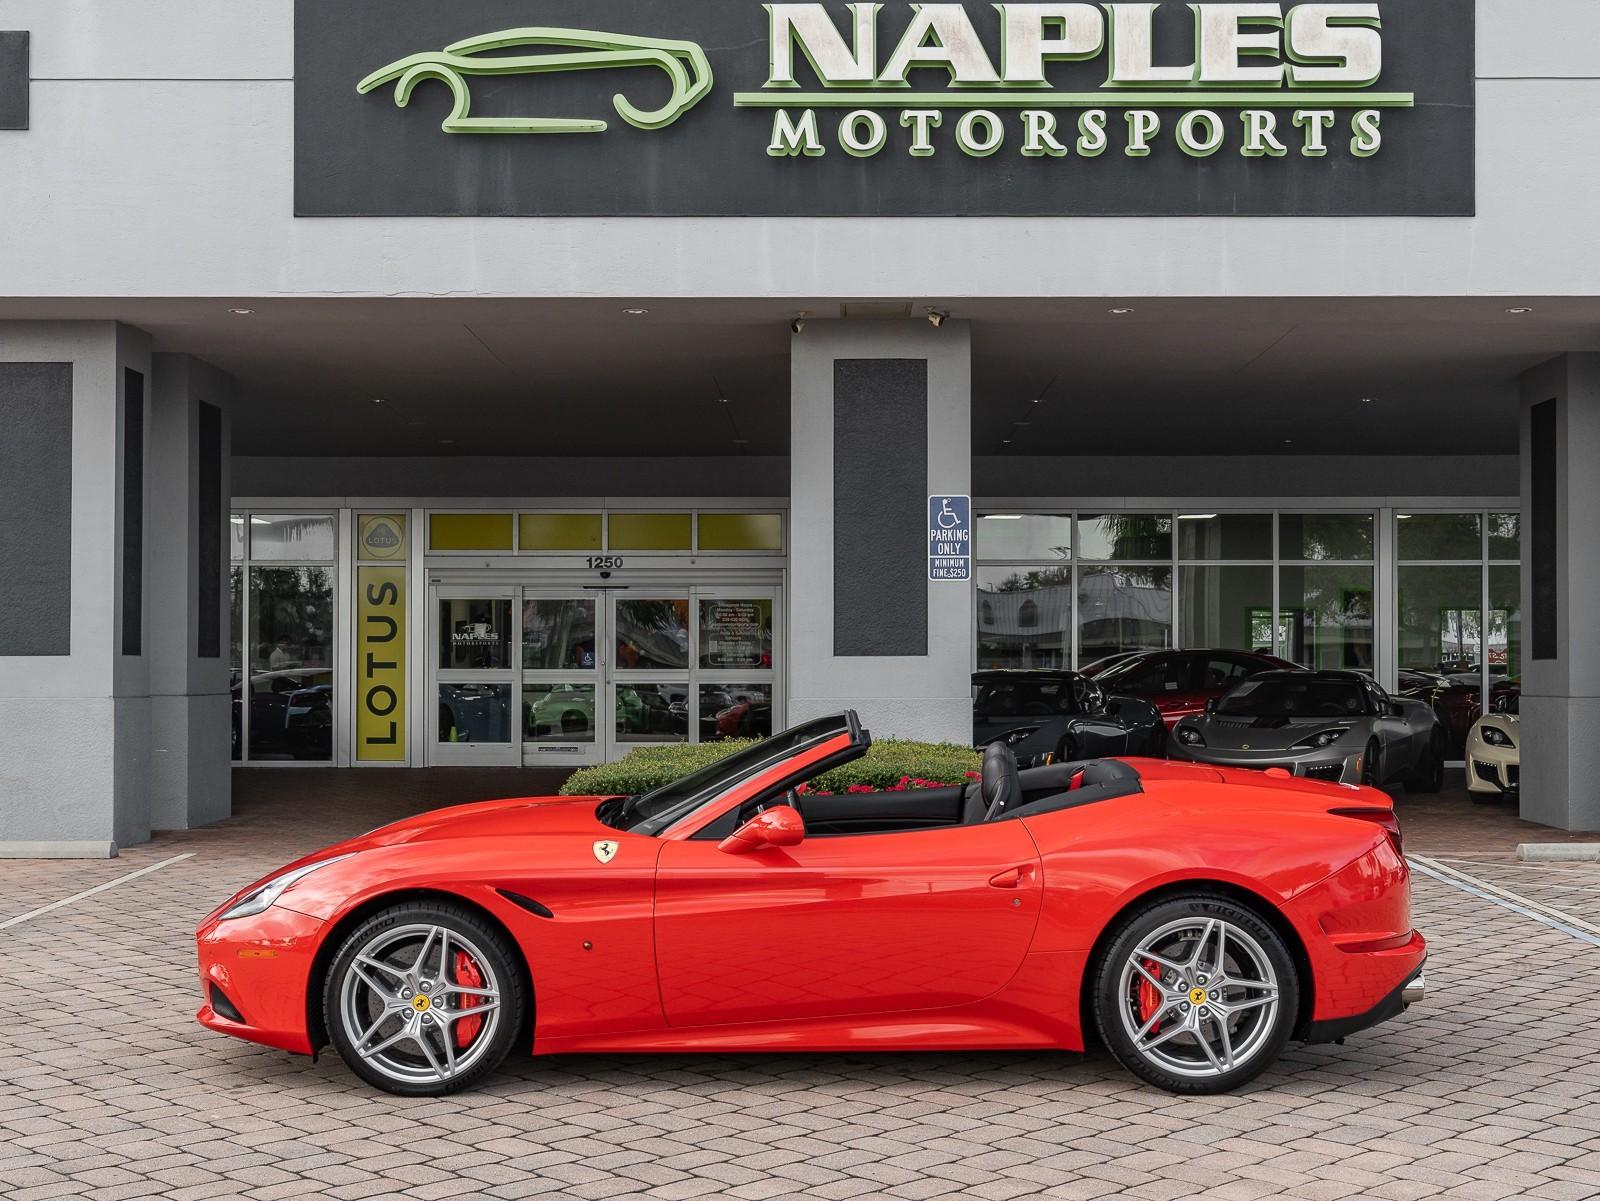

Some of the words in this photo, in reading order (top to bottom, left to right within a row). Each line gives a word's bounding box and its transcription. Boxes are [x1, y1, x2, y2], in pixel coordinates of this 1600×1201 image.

[761, 2, 1382, 88] NAPLES
[766, 107, 1382, 157] MOTORSPORTS
[931, 530, 968, 541] PARKING
[938, 543, 961, 554] ONLY
[586, 556, 624, 569] 1250
[935, 559, 964, 567] MINIMUM
[452, 632, 499, 640] NAPLES
[366, 582, 398, 744] LOTUS
[1207, 902, 1271, 942] MICHELIN
